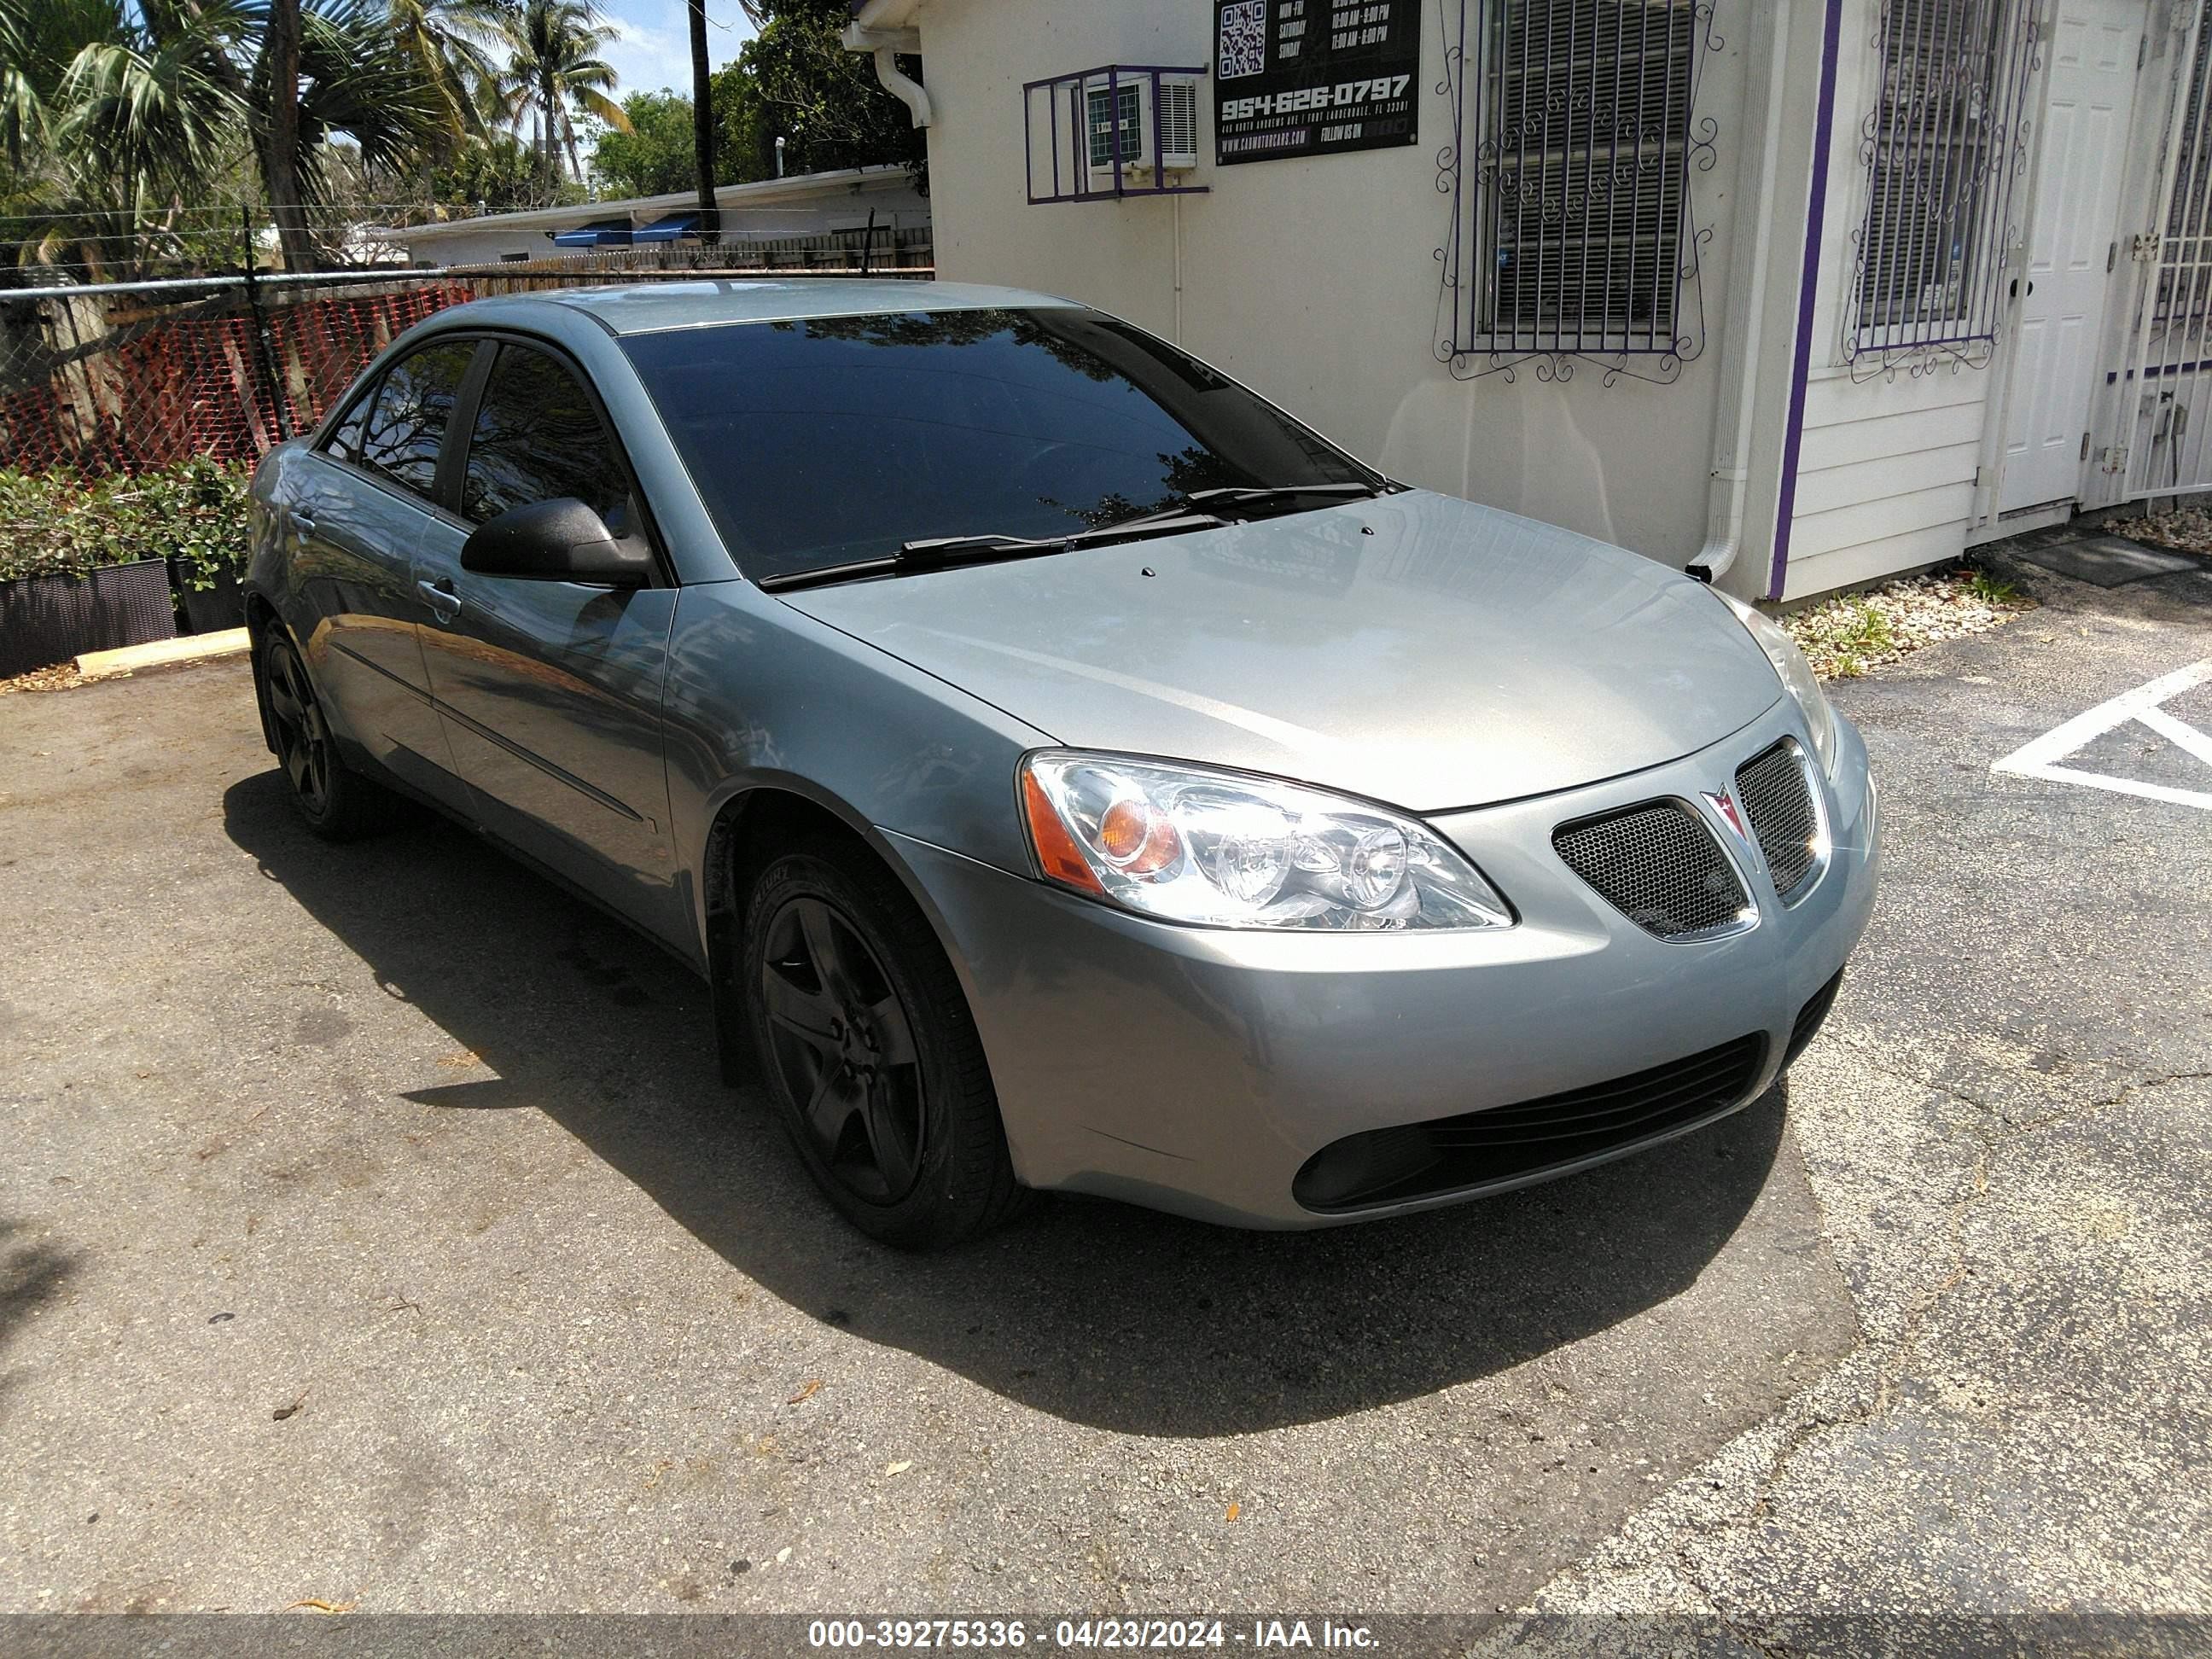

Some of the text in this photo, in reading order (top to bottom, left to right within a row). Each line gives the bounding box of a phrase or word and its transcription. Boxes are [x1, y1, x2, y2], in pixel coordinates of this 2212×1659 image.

[1348, 9, 1359, 26] AM
[1378, 3, 1389, 20] PM
[1279, 20, 1307, 38] SATURDAY
[1347, 30, 1358, 47] AM
[1377, 25, 1388, 42] PM
[1279, 40, 1301, 59] SUNDAY
[1222, 74, 1411, 121] 954-626-0797
[1307, 112, 1324, 123] FORT
[1321, 126, 1343, 143] FOLLOW
